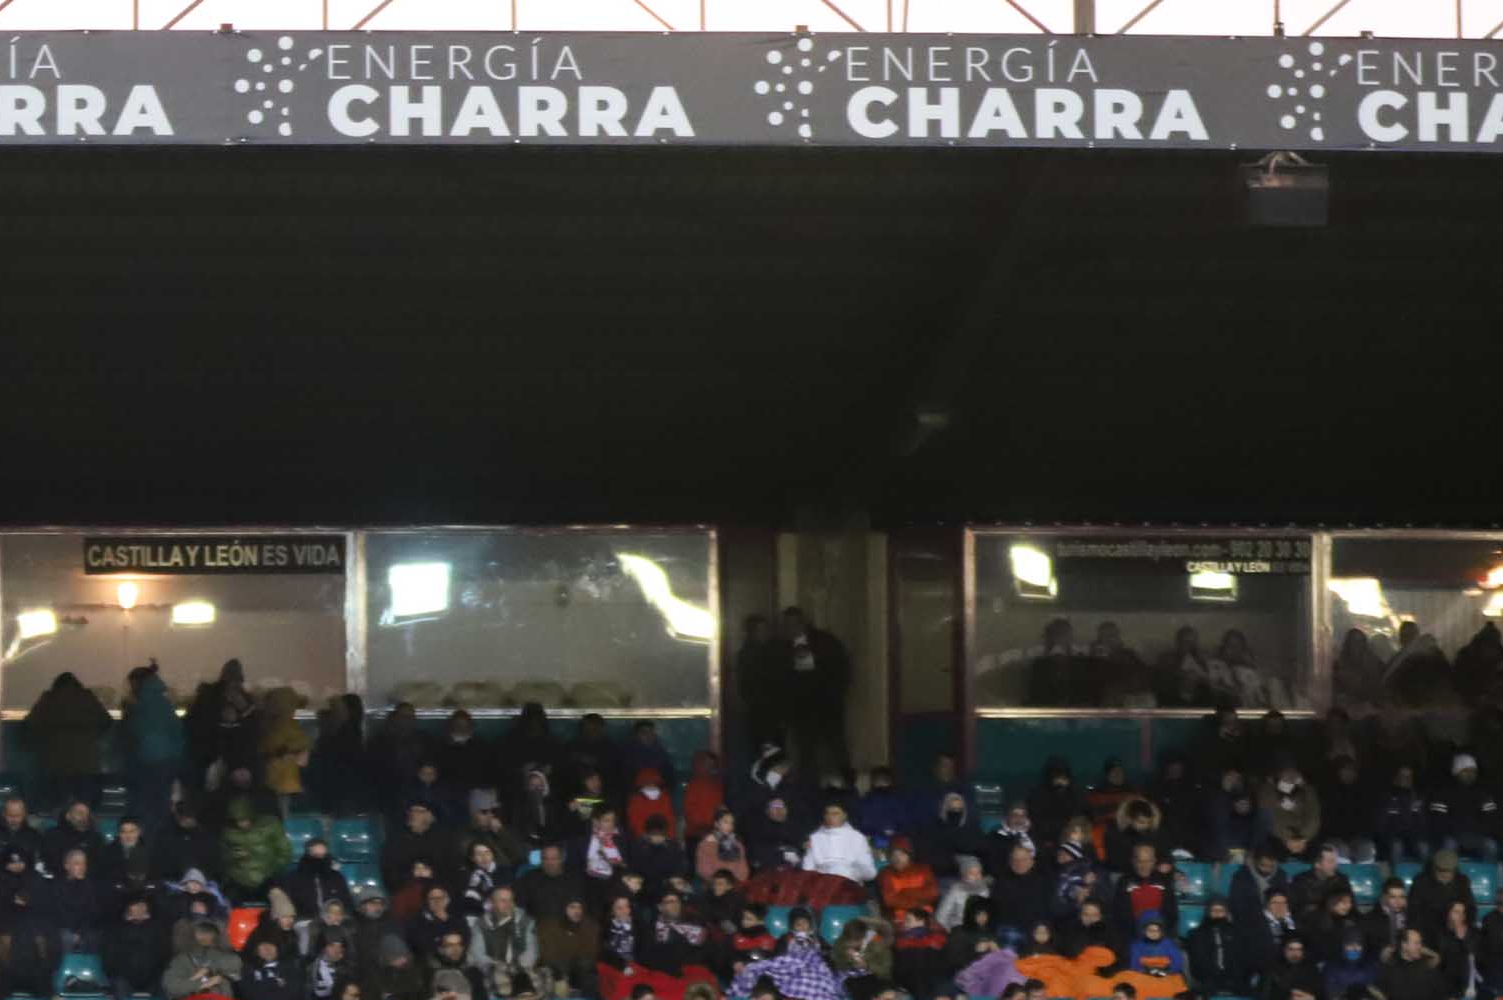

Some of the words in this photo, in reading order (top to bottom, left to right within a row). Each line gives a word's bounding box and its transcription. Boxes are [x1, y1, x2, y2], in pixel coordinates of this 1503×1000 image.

[326, 37, 583, 81] ENERGÍA
[845, 39, 1099, 83] ENERGÍA
[327, 84, 696, 137] CHARRA
[846, 85, 1211, 141] CHARRA
[87, 544, 184, 568] CASTILLA
[182, 544, 198, 567] Y
[203, 539, 258, 568] LEÓN
[262, 544, 288, 567] ES
[291, 543, 341, 567] VIDA
